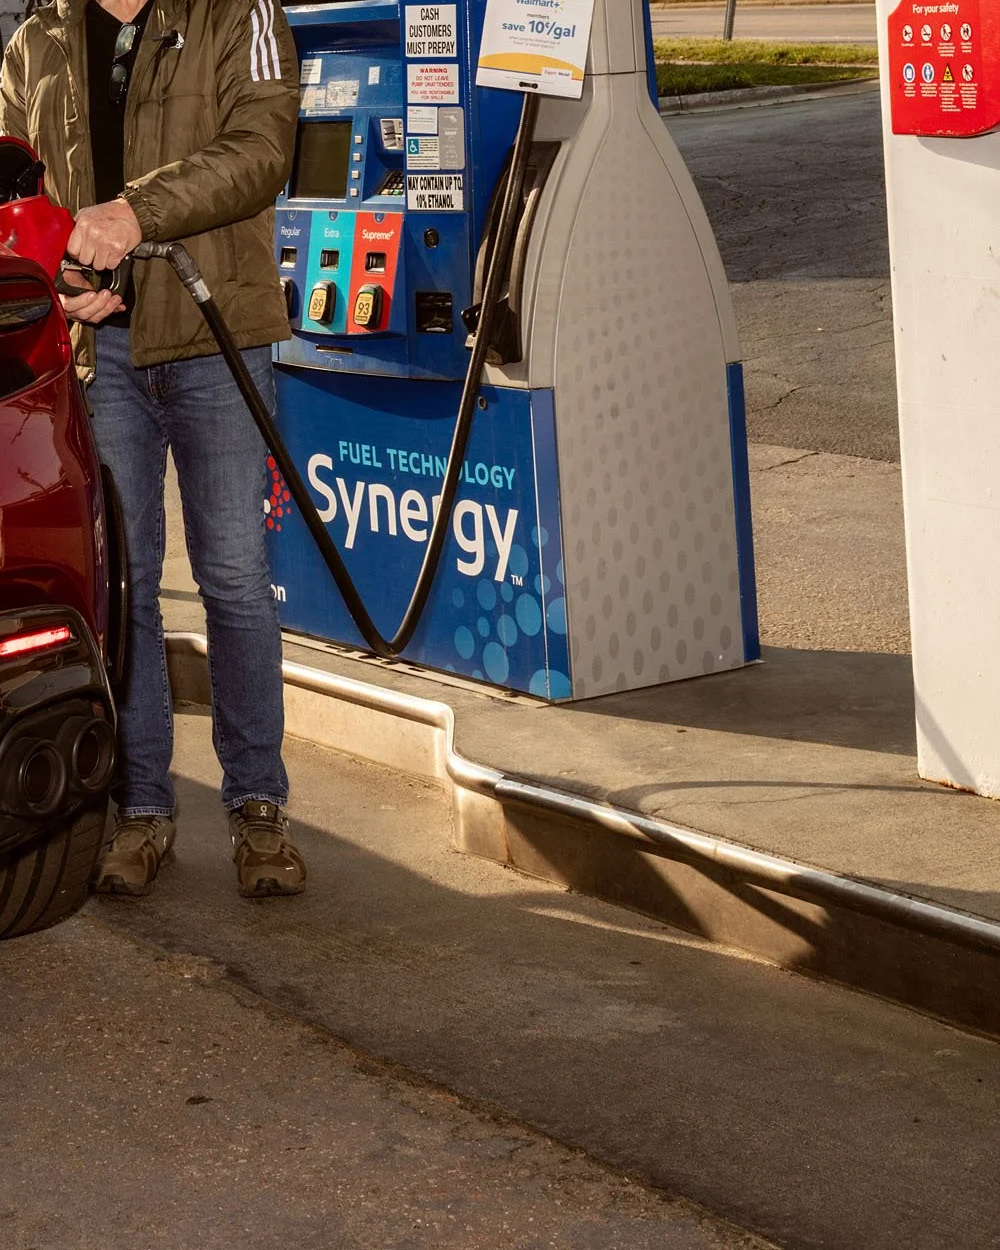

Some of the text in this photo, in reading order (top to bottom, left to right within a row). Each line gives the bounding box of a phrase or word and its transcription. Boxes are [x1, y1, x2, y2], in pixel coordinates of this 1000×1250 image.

[421, 8, 439, 20] CASH
[912, 2, 959, 16] For your safety
[409, 24, 452, 38] CUSTOMERS
[502, 20, 576, 39] save 10¢/gal
[407, 41, 455, 54] MUST PREPAY
[408, 177, 462, 190] MAY CONTAIN UP TO
[416, 194, 454, 208] 10% ETHANOL
[281, 226, 301, 239] Regular
[324, 228, 339, 238] Extra
[312, 298, 324, 310] 89
[358, 302, 370, 315] 93
[338, 441, 515, 490] FUEL TECHNLOGY
